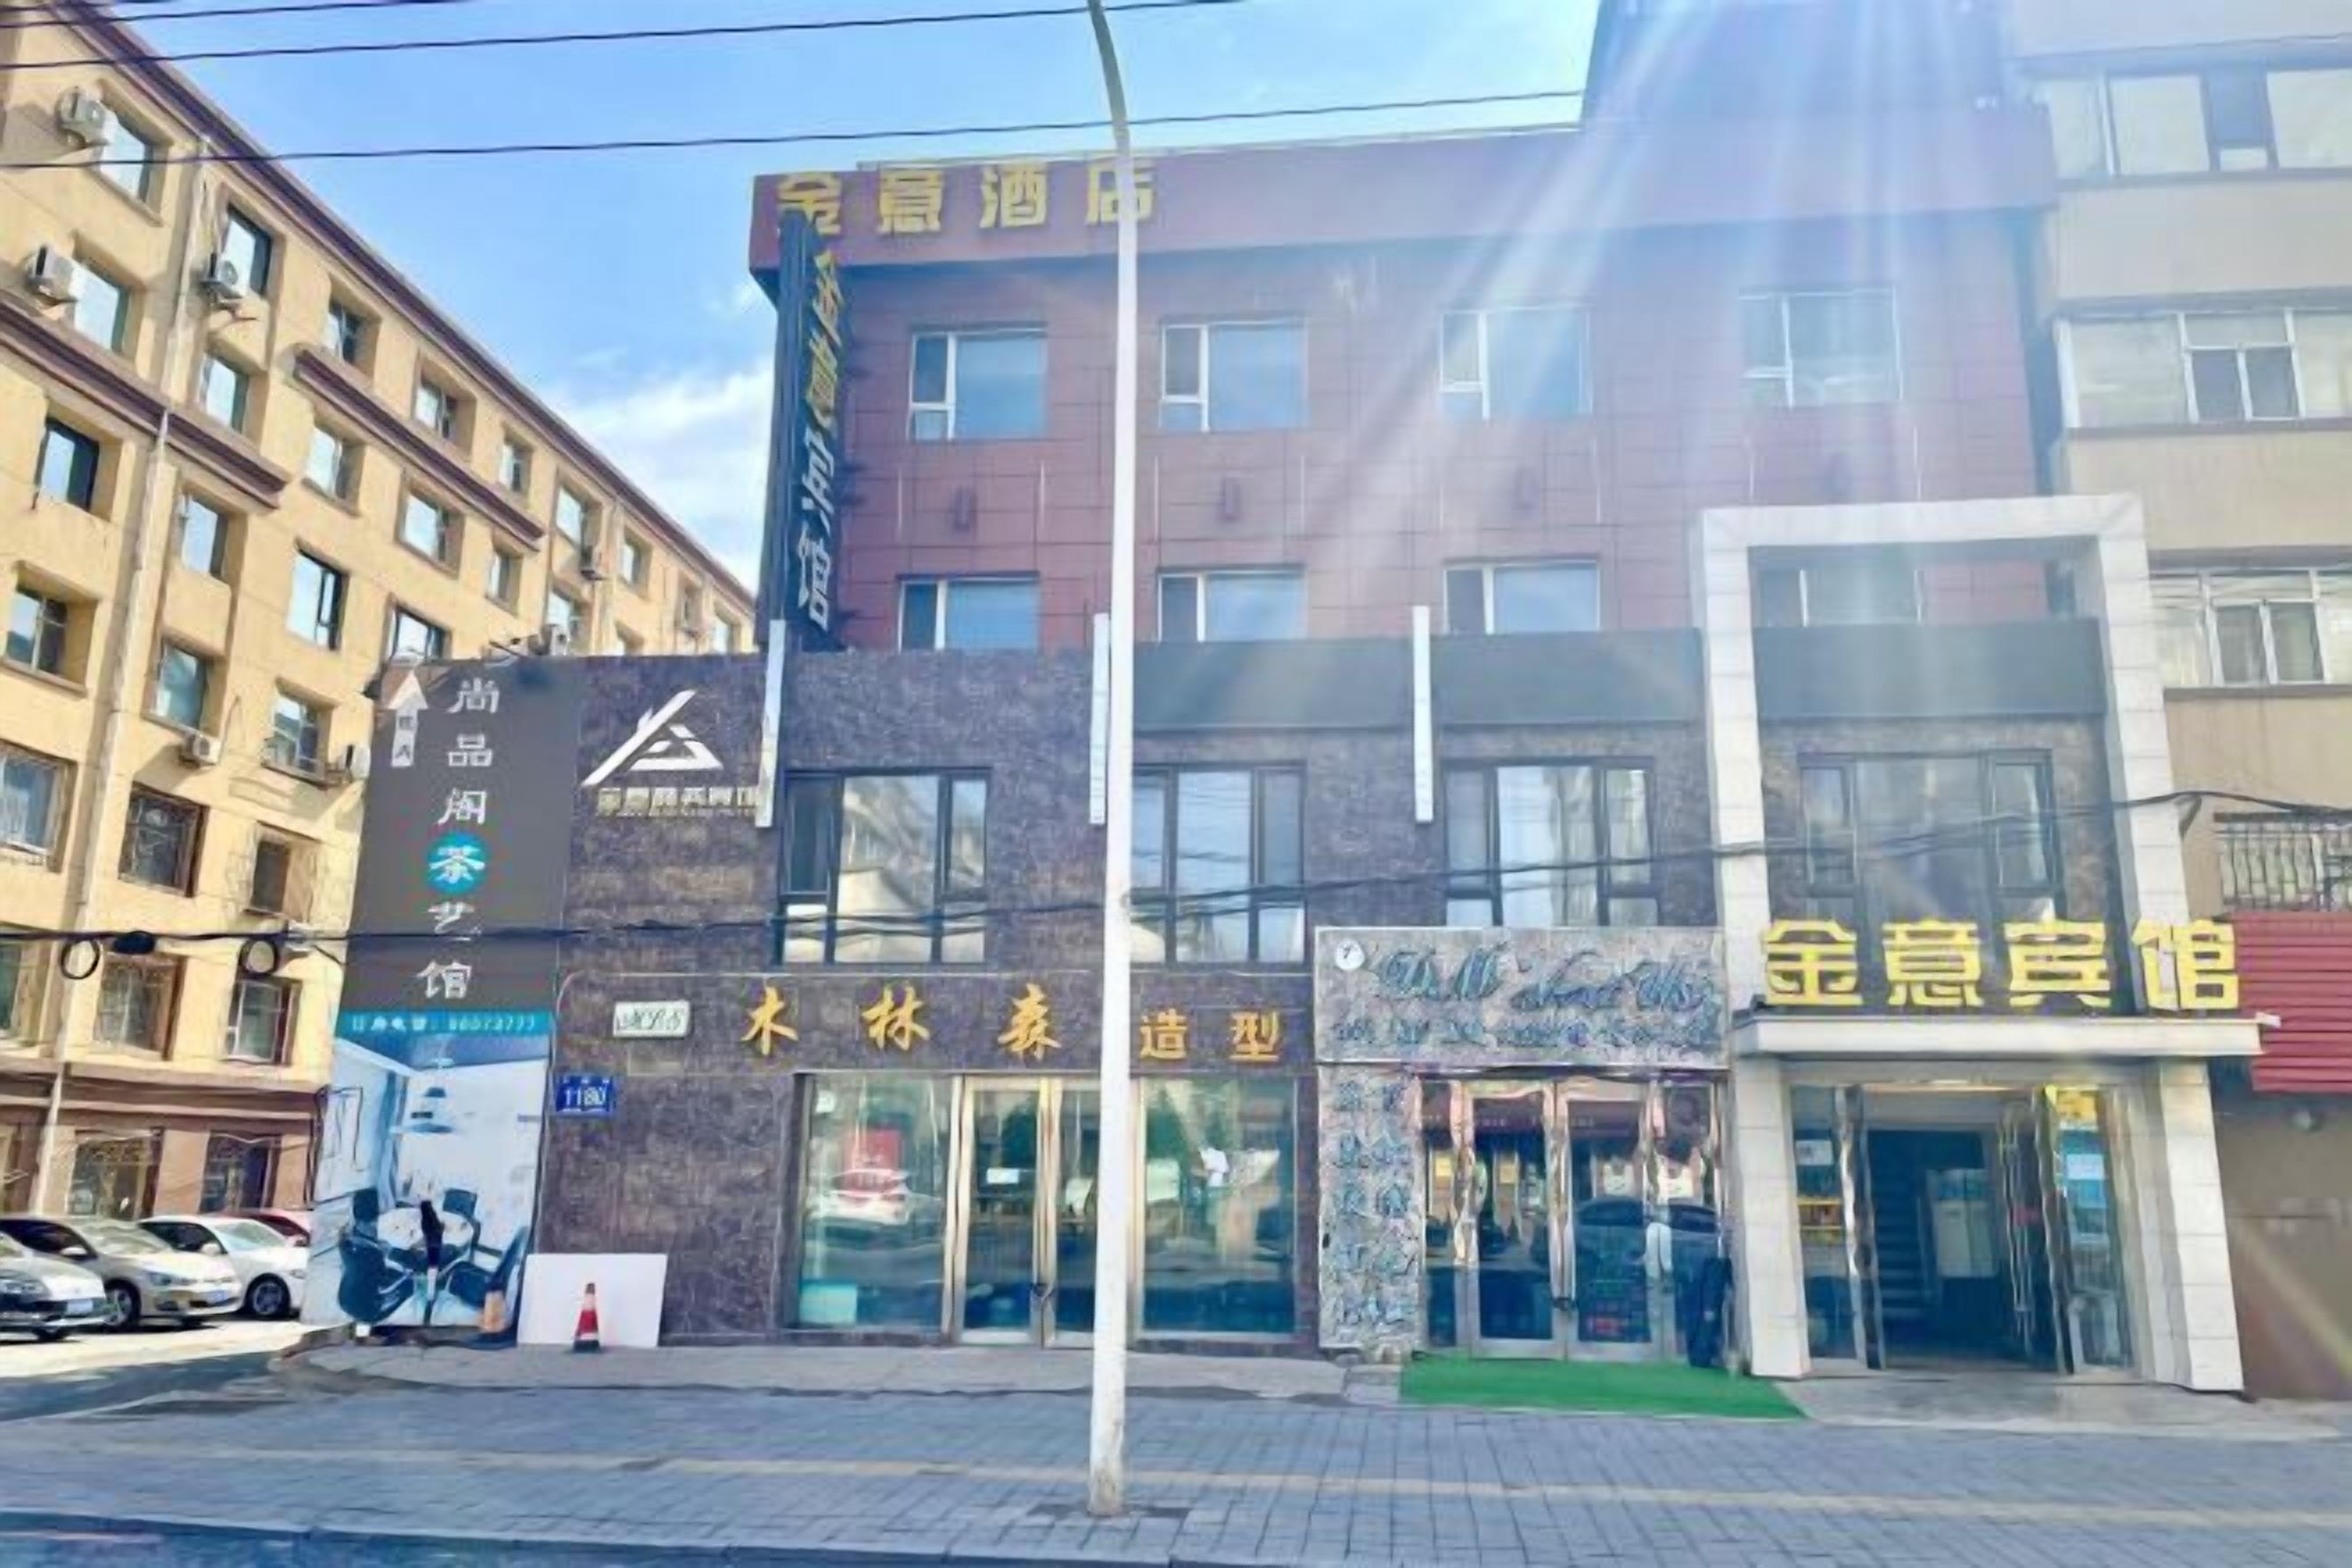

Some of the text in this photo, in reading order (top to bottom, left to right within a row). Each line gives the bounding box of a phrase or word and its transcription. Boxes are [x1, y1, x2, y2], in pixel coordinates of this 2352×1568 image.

[776, 155, 1155, 236] 金意酒店
[1762, 918, 2240, 1010] 金意宾馆
